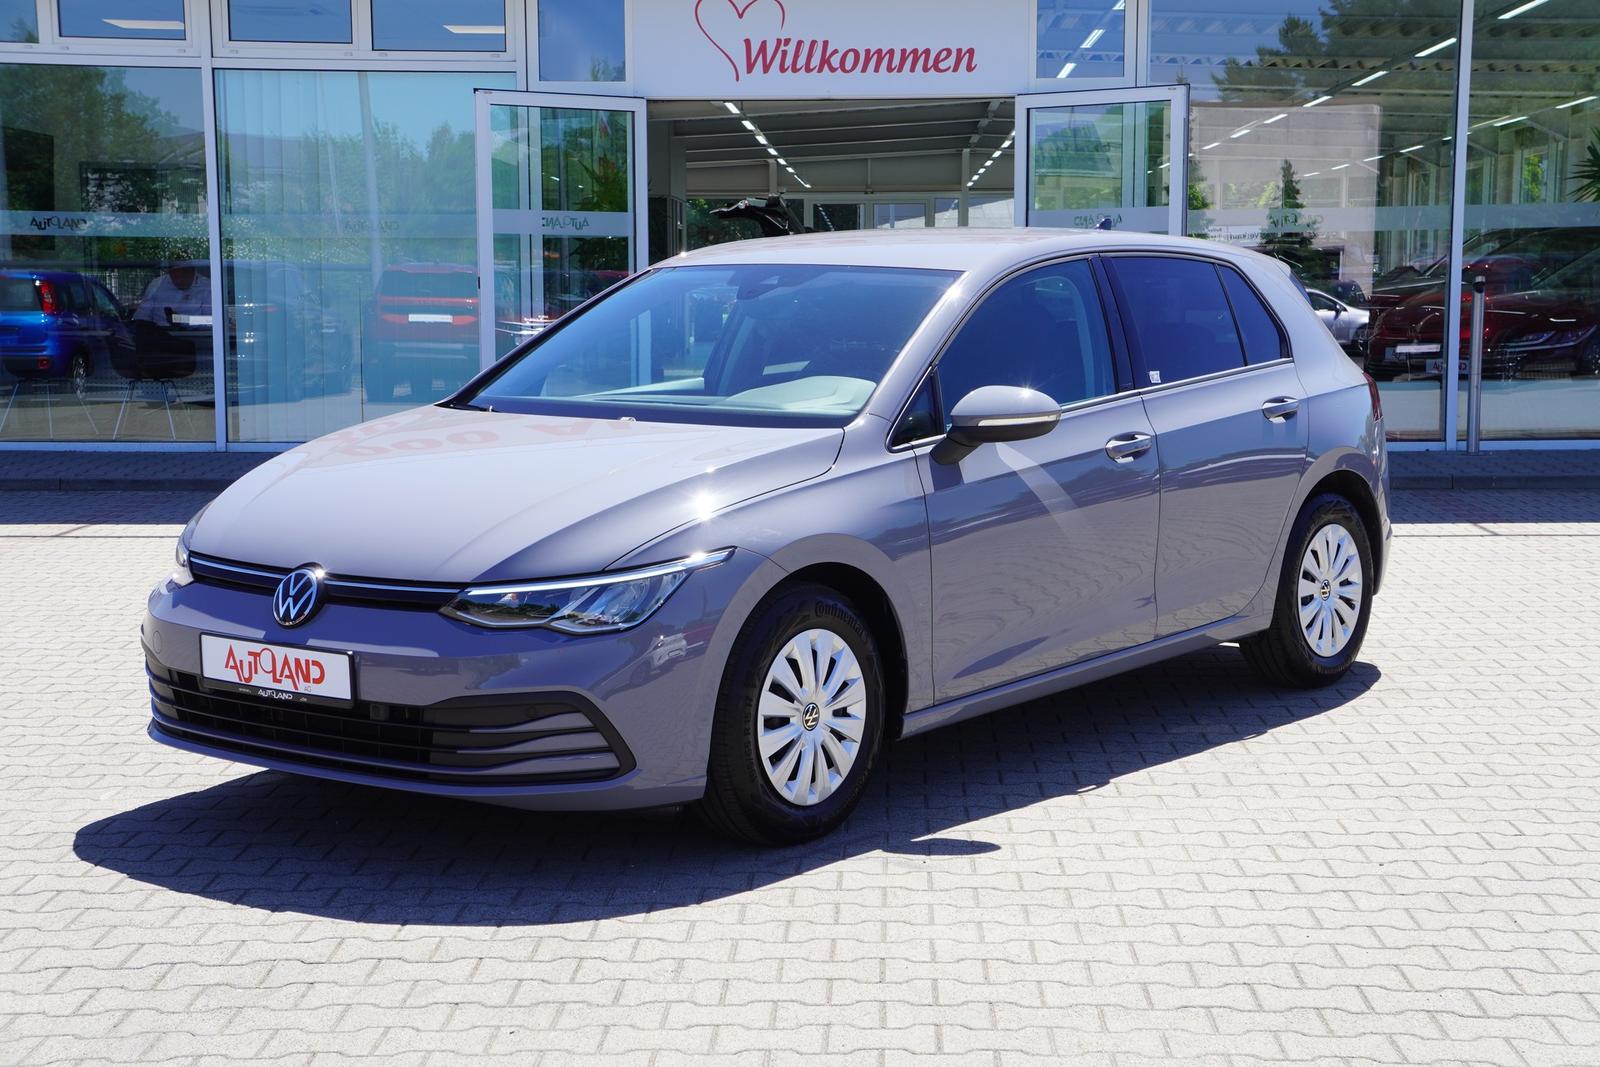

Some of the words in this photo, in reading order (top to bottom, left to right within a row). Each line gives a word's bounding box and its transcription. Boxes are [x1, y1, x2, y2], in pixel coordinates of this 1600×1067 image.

[743, 37, 977, 74] Willkommen
[225, 644, 326, 690] AUTOLAND
[257, 689, 293, 700] AUTOLAND
